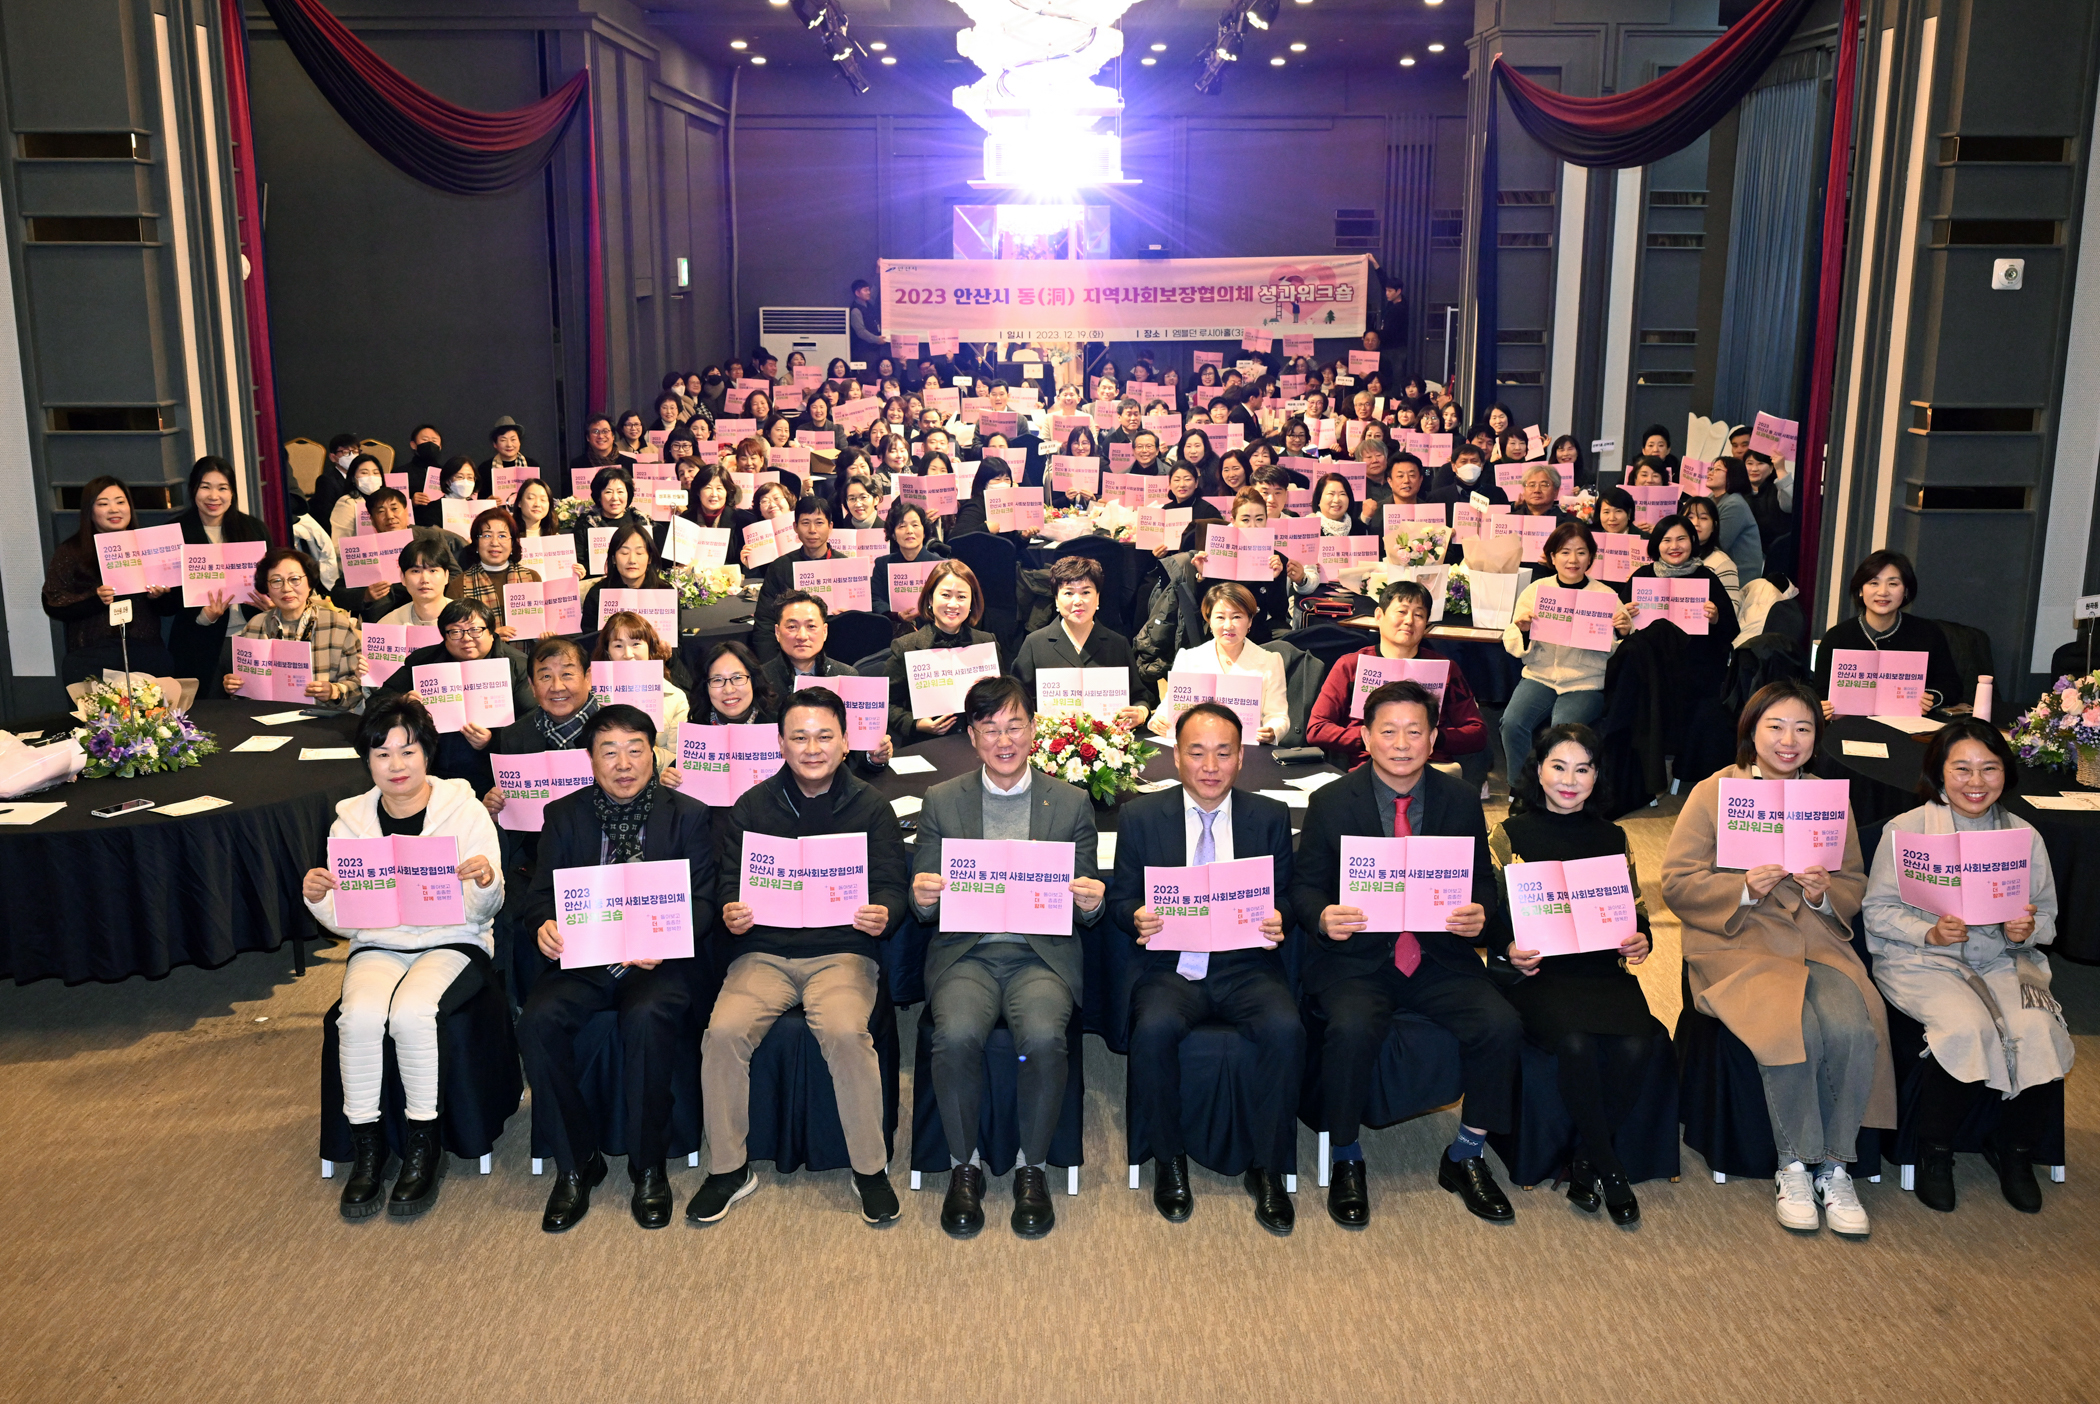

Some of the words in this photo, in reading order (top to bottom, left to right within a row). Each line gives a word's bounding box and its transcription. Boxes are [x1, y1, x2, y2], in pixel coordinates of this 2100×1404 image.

[894, 288, 946, 304] 2023
[954, 288, 1010, 305] 안산시
[1017, 287, 1075, 306] 동(洞)
[1083, 286, 1254, 304] 지역사회보장협의체
[1258, 283, 1354, 304] 성과워크숍
[1007, 330, 1024, 340] 일시
[1144, 330, 1160, 338] 장소
[103, 545, 121, 553] 2023
[1540, 597, 1556, 605] 2023
[367, 636, 385, 644] 2023
[237, 649, 252, 658] 2023
[912, 663, 931, 672] 2023
[1838, 663, 1857, 671] 2023
[1363, 669, 1382, 678] 2023
[420, 679, 438, 687] 2023
[421, 687, 439, 696] 안산시
[1174, 686, 1192, 694] 2023
[422, 693, 462, 705] 성과워크숍
[1043, 698, 1081, 706] 과워크숍
[684, 740, 706, 750] 2023
[683, 750, 705, 759] 안산시
[683, 760, 730, 772] 성과워크숍
[499, 771, 520, 779] 2023
[500, 780, 522, 788] 안산시
[1728, 797, 1754, 808] 2023
[1728, 808, 1754, 819] 안산시
[1757, 810, 1766, 820] 동
[1728, 820, 1783, 833] 성과워크숍
[750, 852, 774, 864] 2023
[1903, 849, 1930, 861] 2023
[338, 858, 363, 867] 2023
[950, 858, 976, 868] 2023
[1349, 857, 1375, 867] 2023
[1903, 859, 1930, 872] 안산시
[1933, 864, 1942, 873] 동
[338, 869, 364, 878] 안산시
[367, 869, 376, 877] 동
[750, 864, 774, 876] 안산시
[777, 868, 785, 877] 동
[950, 870, 976, 879] 안산시
[979, 871, 987, 880] 동
[1349, 868, 1376, 878] 안산시
[1378, 870, 1386, 879] 동
[1904, 868, 1961, 886] 성과워크숍
[340, 878, 396, 890] 성과워크숍
[749, 876, 803, 890] 성과워크숍
[950, 881, 1005, 893] 성과워크숍
[1349, 881, 1405, 892] 성과워크숍
[1517, 882, 1542, 892] 2023
[564, 888, 590, 899] 2023
[1154, 885, 1179, 894] 2023
[1154, 896, 1179, 904] 안산시
[1182, 896, 1190, 904] 동
[1518, 893, 1544, 904] 안산시
[1546, 892, 1554, 901] 동
[564, 901, 591, 911] 안산시
[1154, 906, 1209, 916] 성과워크숍
[1520, 903, 1571, 916] 성과워크숍
[566, 910, 622, 925] 성과크숍
